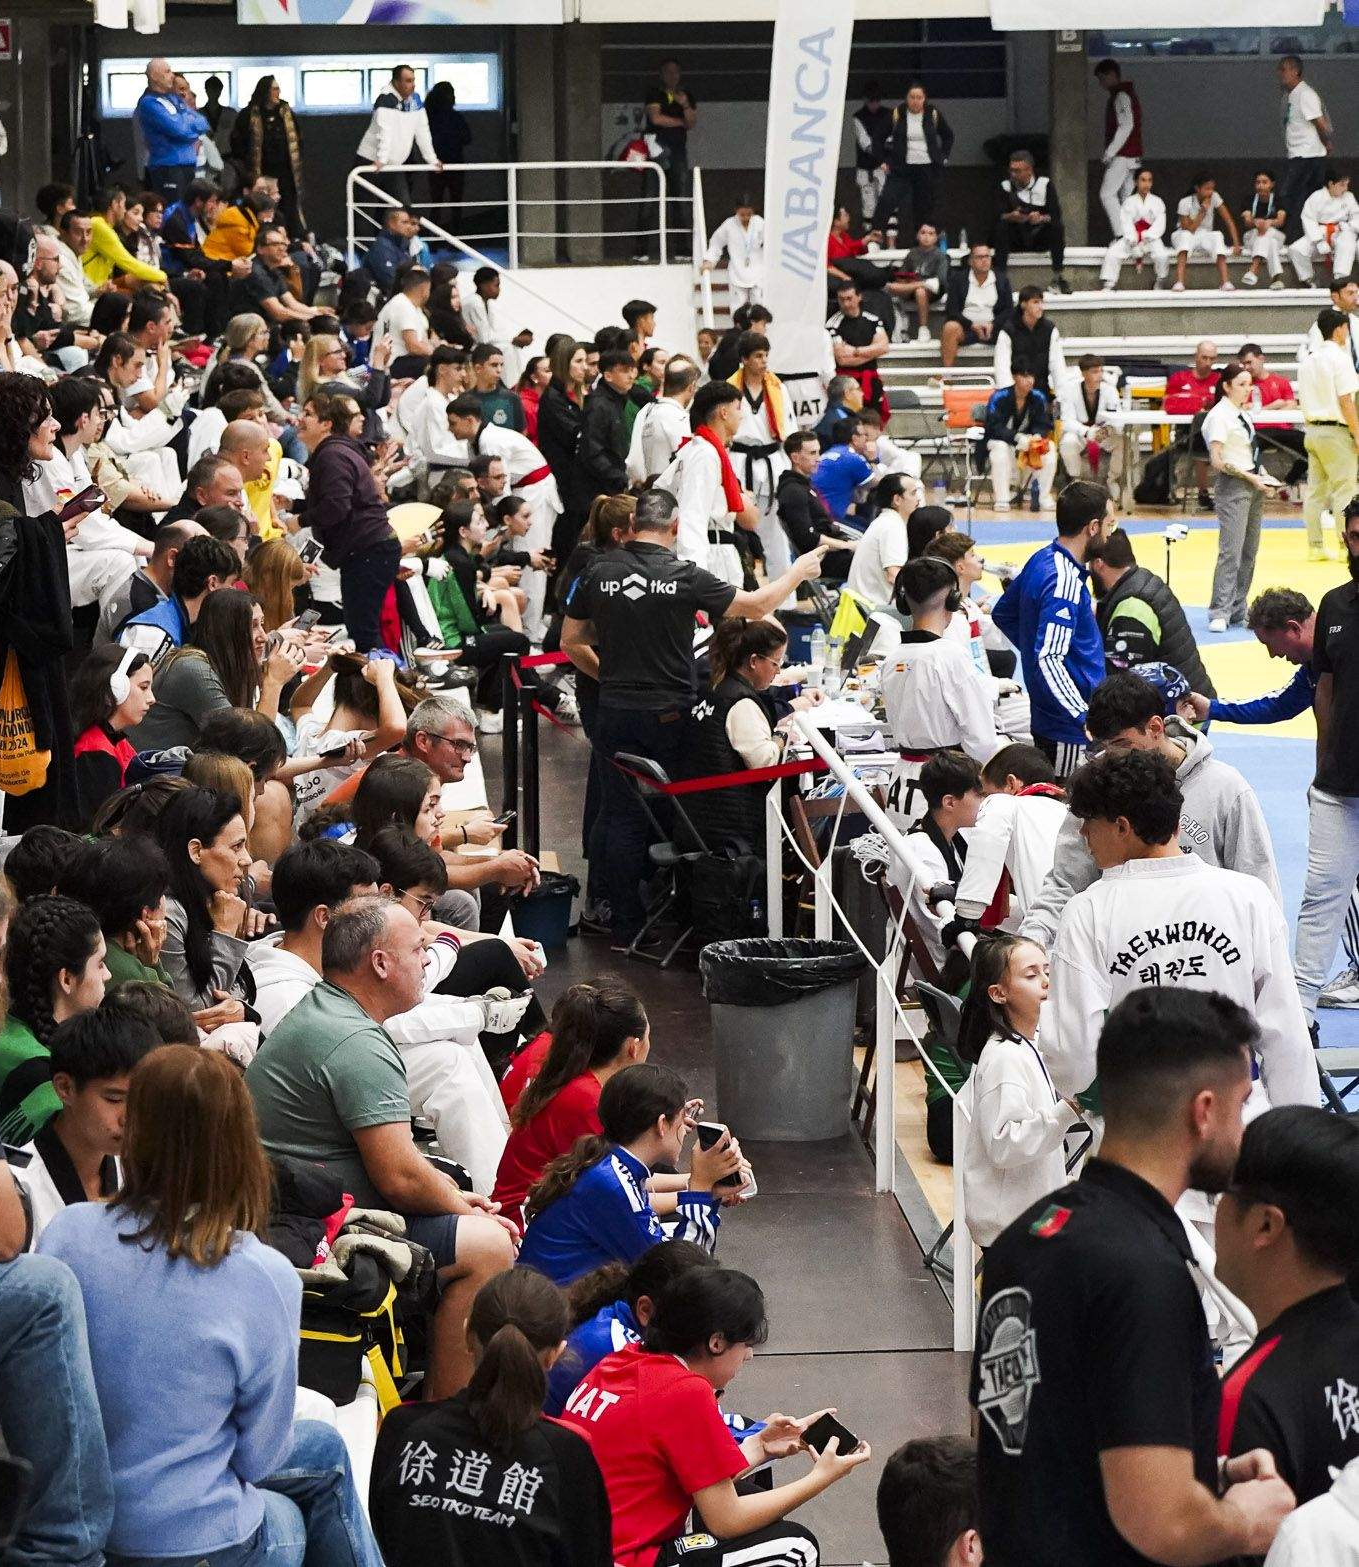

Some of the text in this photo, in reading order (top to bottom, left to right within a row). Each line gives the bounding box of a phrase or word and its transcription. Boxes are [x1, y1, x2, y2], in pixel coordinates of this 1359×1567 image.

[782, 27, 836, 262] ABANCA
[600, 580, 678, 597] up tkd
[1109, 920, 1241, 977] TAEKWONDO
[1138, 954, 1208, 986] 태권도
[398, 1439, 544, 1516] 徐道館
